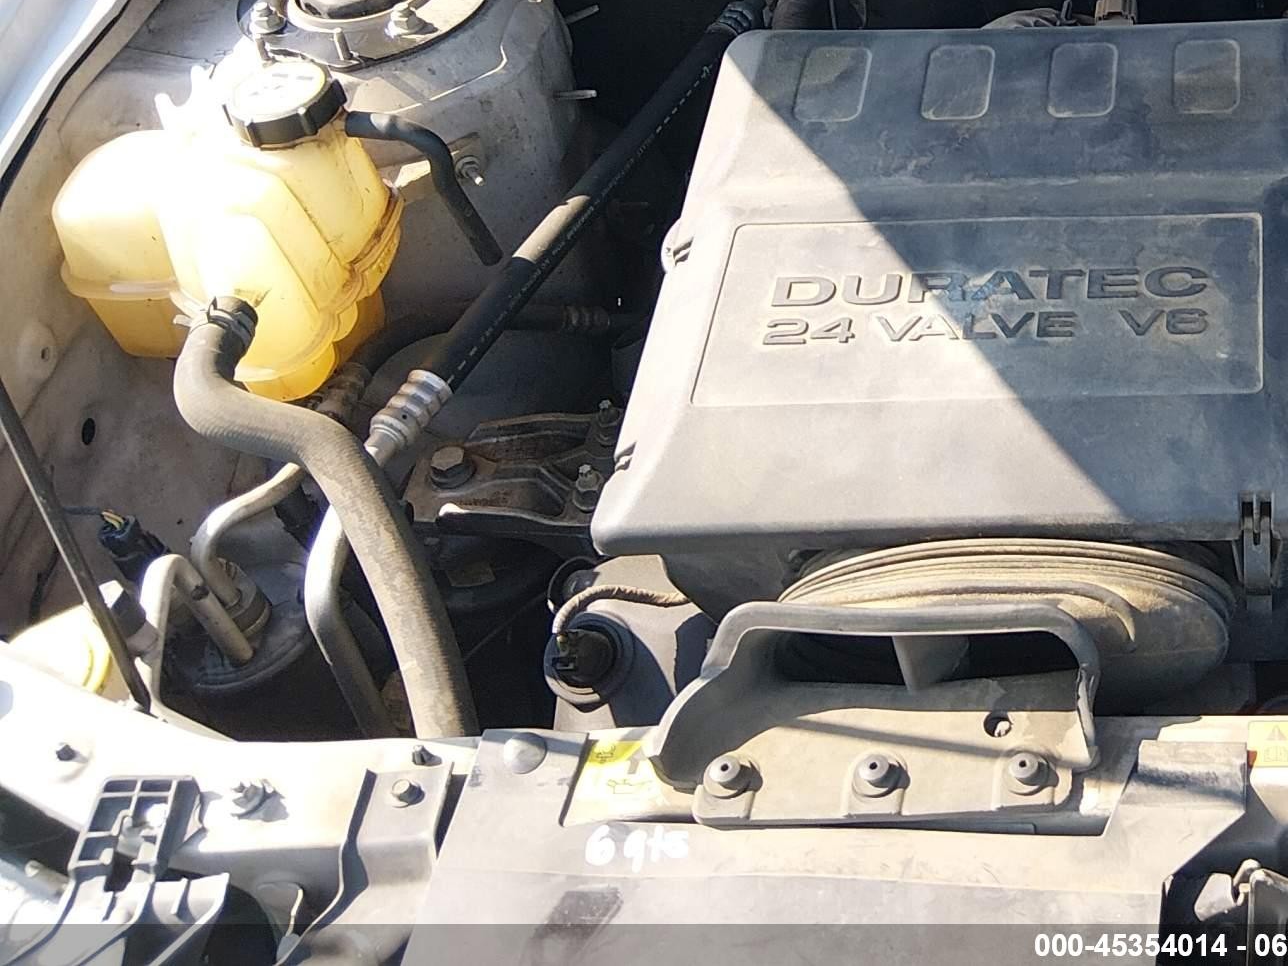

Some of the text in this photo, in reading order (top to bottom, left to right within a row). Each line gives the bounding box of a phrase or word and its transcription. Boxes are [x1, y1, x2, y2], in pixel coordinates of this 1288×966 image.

[770, 266, 1209, 307] DURATEC
[762, 307, 1209, 345] 24 VALVE V6
[585, 824, 616, 866] 6
